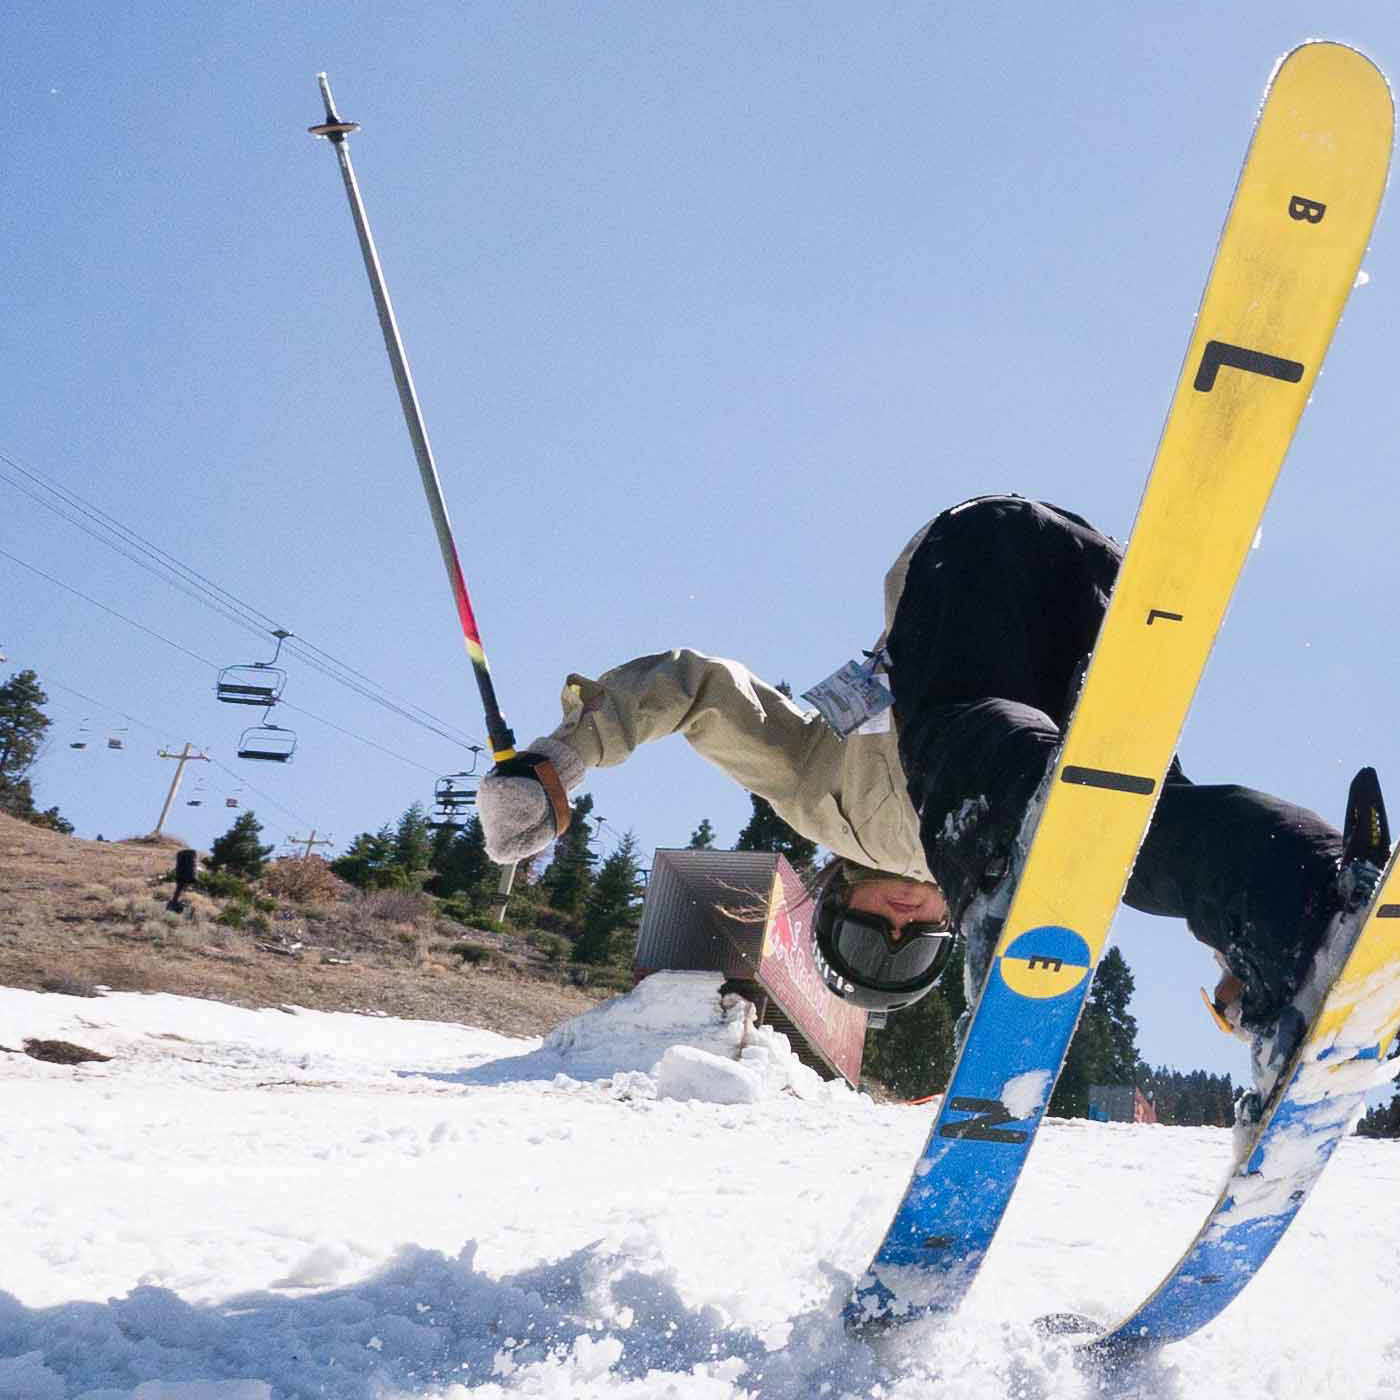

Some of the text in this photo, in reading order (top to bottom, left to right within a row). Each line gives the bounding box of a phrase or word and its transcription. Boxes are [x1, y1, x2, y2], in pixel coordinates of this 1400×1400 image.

[1288, 195, 1327, 224] B
[1193, 340, 1305, 393] L
[1146, 608, 1183, 625] L
[1028, 955, 1064, 972] E
